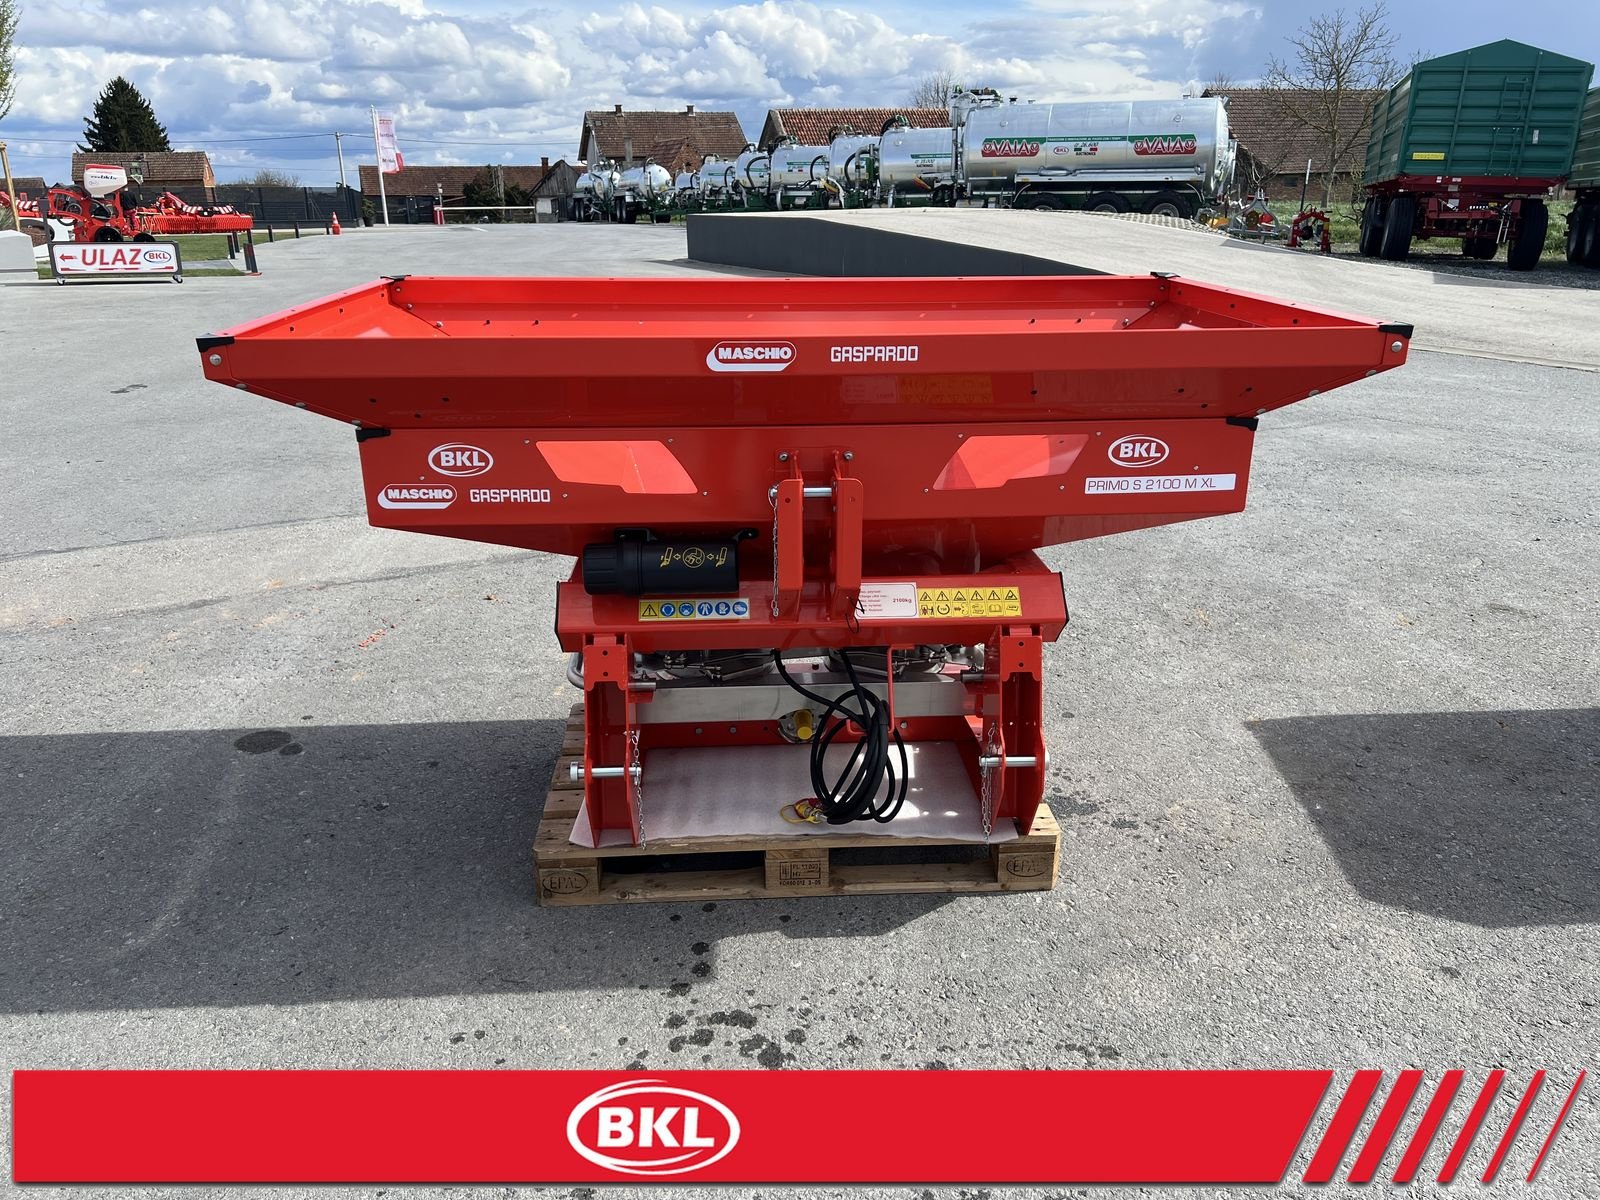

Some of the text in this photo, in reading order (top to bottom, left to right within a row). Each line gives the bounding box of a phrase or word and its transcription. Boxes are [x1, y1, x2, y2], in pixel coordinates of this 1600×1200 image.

[992, 139, 1031, 155] VAIA
[1144, 136, 1186, 153] VAIA
[81, 248, 142, 266] ULAZ
[148, 252, 168, 260] BKL
[718, 345, 919, 362] MASCHIO GASPARDO
[1119, 442, 1162, 458] BKL
[440, 450, 486, 467] BKL
[1087, 477, 1217, 491] PRIMO S 2100 M XL
[387, 488, 551, 503] MASCHIO GASPARDO
[550, 876, 582, 889] EPAL
